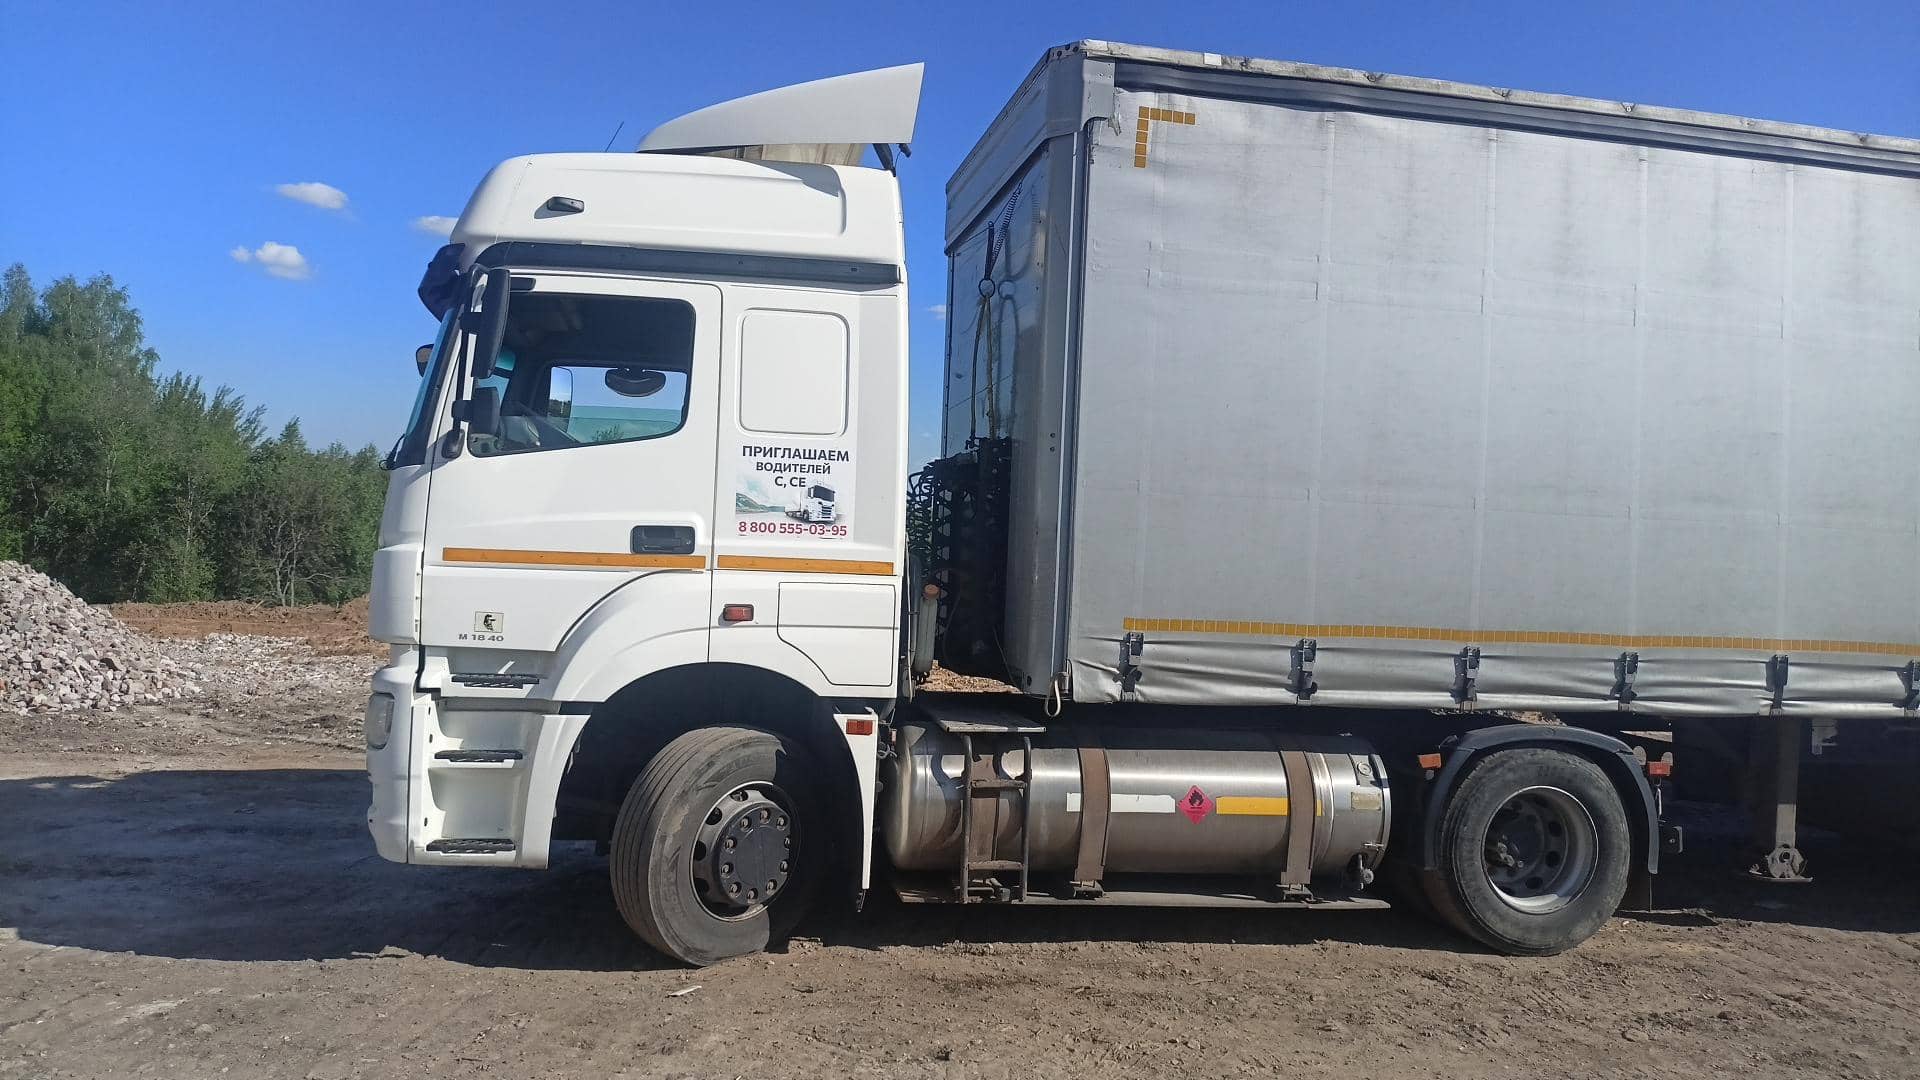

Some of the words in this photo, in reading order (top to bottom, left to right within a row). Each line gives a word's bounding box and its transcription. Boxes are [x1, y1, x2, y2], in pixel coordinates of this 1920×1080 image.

[742, 445, 850, 462] ПРИГЛАШАЕМ
[756, 462, 831, 475] ВОДИТЕЛЕЙ
[738, 521, 747, 533] 8
[749, 522, 776, 534] 800
[779, 523, 847, 536] 555-03-95
